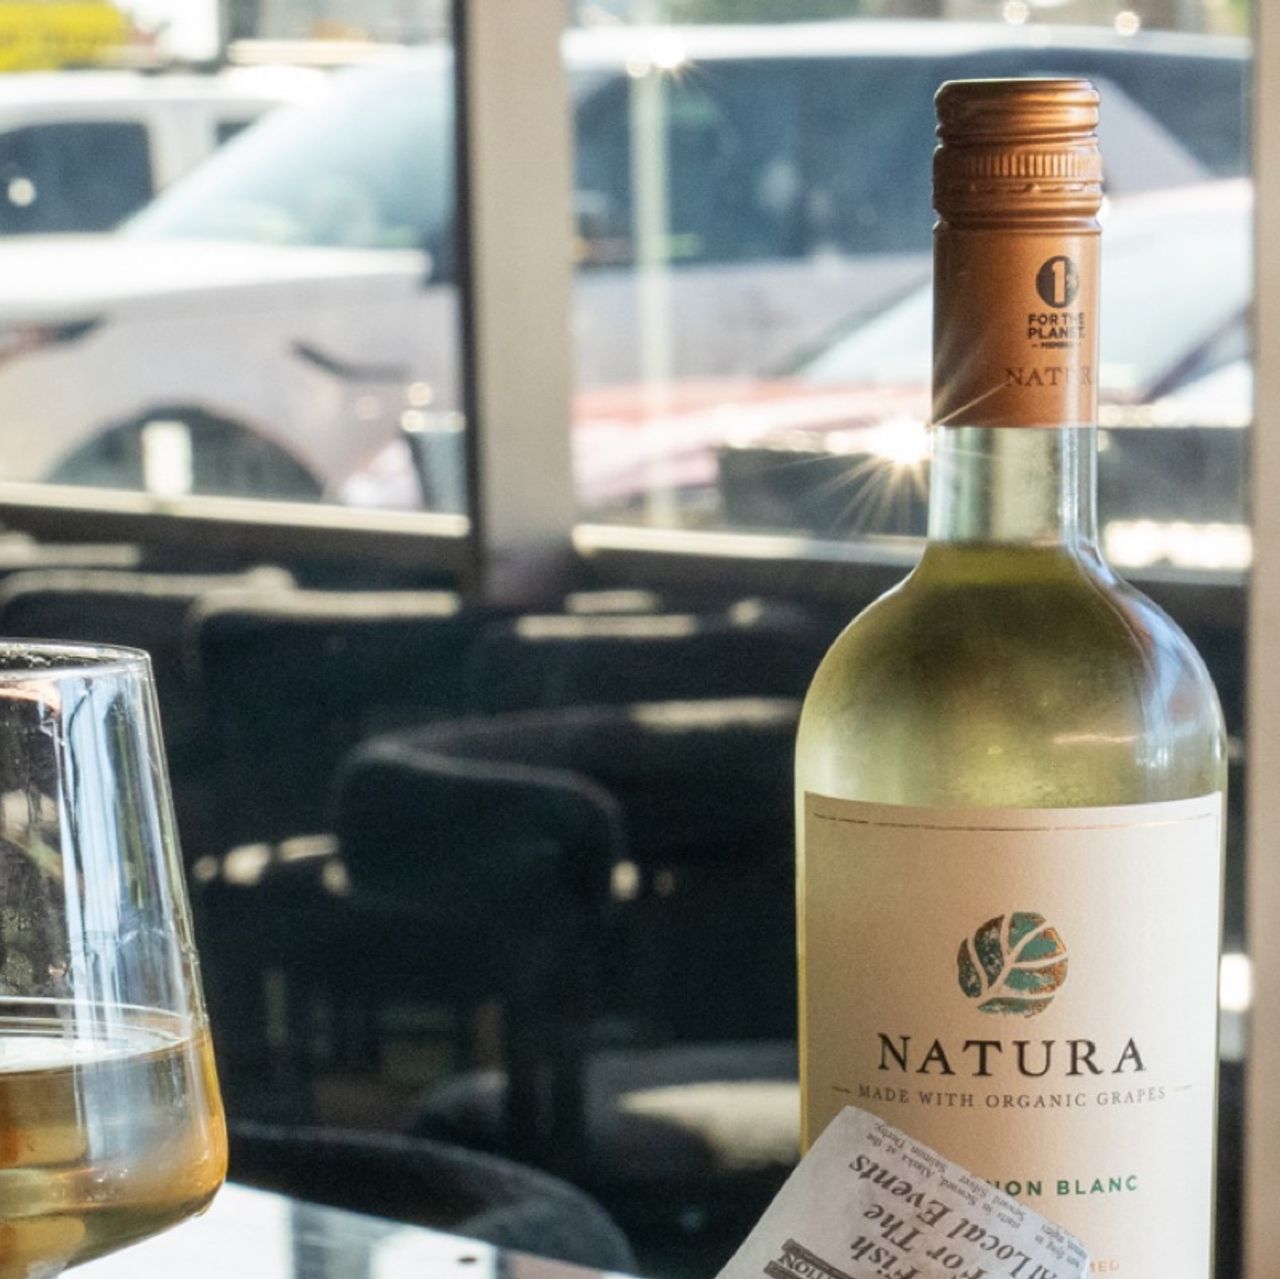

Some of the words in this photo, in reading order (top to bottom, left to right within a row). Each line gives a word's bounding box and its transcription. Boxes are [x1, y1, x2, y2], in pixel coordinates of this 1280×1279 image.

[1028, 312, 1058, 325] FOR
[877, 1031, 1147, 1078] NATURA
[858, 1084, 910, 1103] MADE
[920, 1089, 975, 1108] WITH
[985, 1091, 1087, 1109] ORGANIC
[1096, 1085, 1167, 1106] GRAPES
[847, 1152, 953, 1228] Events
[1056, 1174, 1139, 1196] BLANC
[861, 1201, 923, 1253] The
[945, 1215, 1032, 1279] Local
